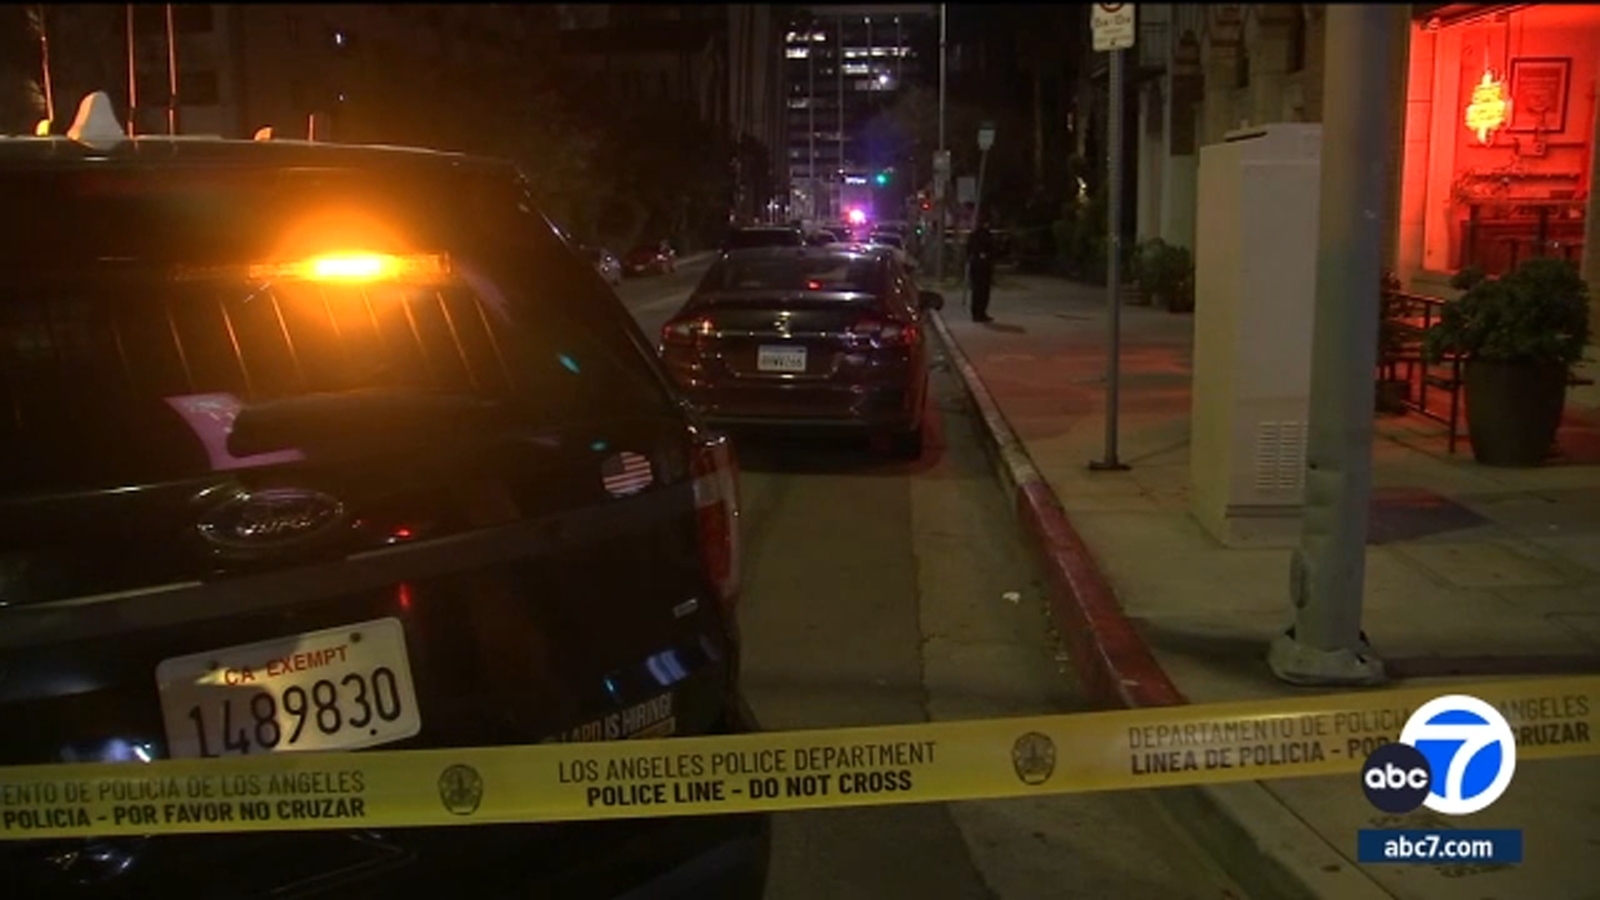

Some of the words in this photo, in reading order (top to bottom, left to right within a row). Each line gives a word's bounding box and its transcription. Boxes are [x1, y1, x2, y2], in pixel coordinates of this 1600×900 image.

[225, 667, 255, 686] CA
[266, 644, 349, 678] EXEMPT
[189, 666, 402, 758] 1489830
[604, 713, 620, 738] IS
[1128, 719, 1293, 749] DEPARTAMENTO
[1302, 714, 1329, 736] DE
[558, 759, 598, 783] LOS
[606, 754, 704, 780] ANGELES
[711, 749, 787, 776] POLICE
[794, 740, 937, 771] DEPARTMENT
[1131, 750, 1198, 775] LINEA
[1205, 748, 1233, 770] DE
[1239, 741, 1326, 768] POLICIA
[64, 781, 92, 803] DE
[98, 776, 181, 801] POLICIA
[186, 773, 216, 799] DE
[220, 773, 261, 796] LOS
[268, 770, 365, 796] ANGELES
[586, 784, 666, 807] POLICE
[673, 781, 726, 803] LINE
[749, 777, 779, 799] DO
[786, 774, 832, 797] NOT
[838, 770, 913, 794] CROSS
[3, 806, 91, 830] POLICIA
[113, 803, 158, 826] POR
[163, 801, 234, 824] FAVOR
[239, 800, 270, 821] NO
[276, 797, 366, 820] CRUZAR
